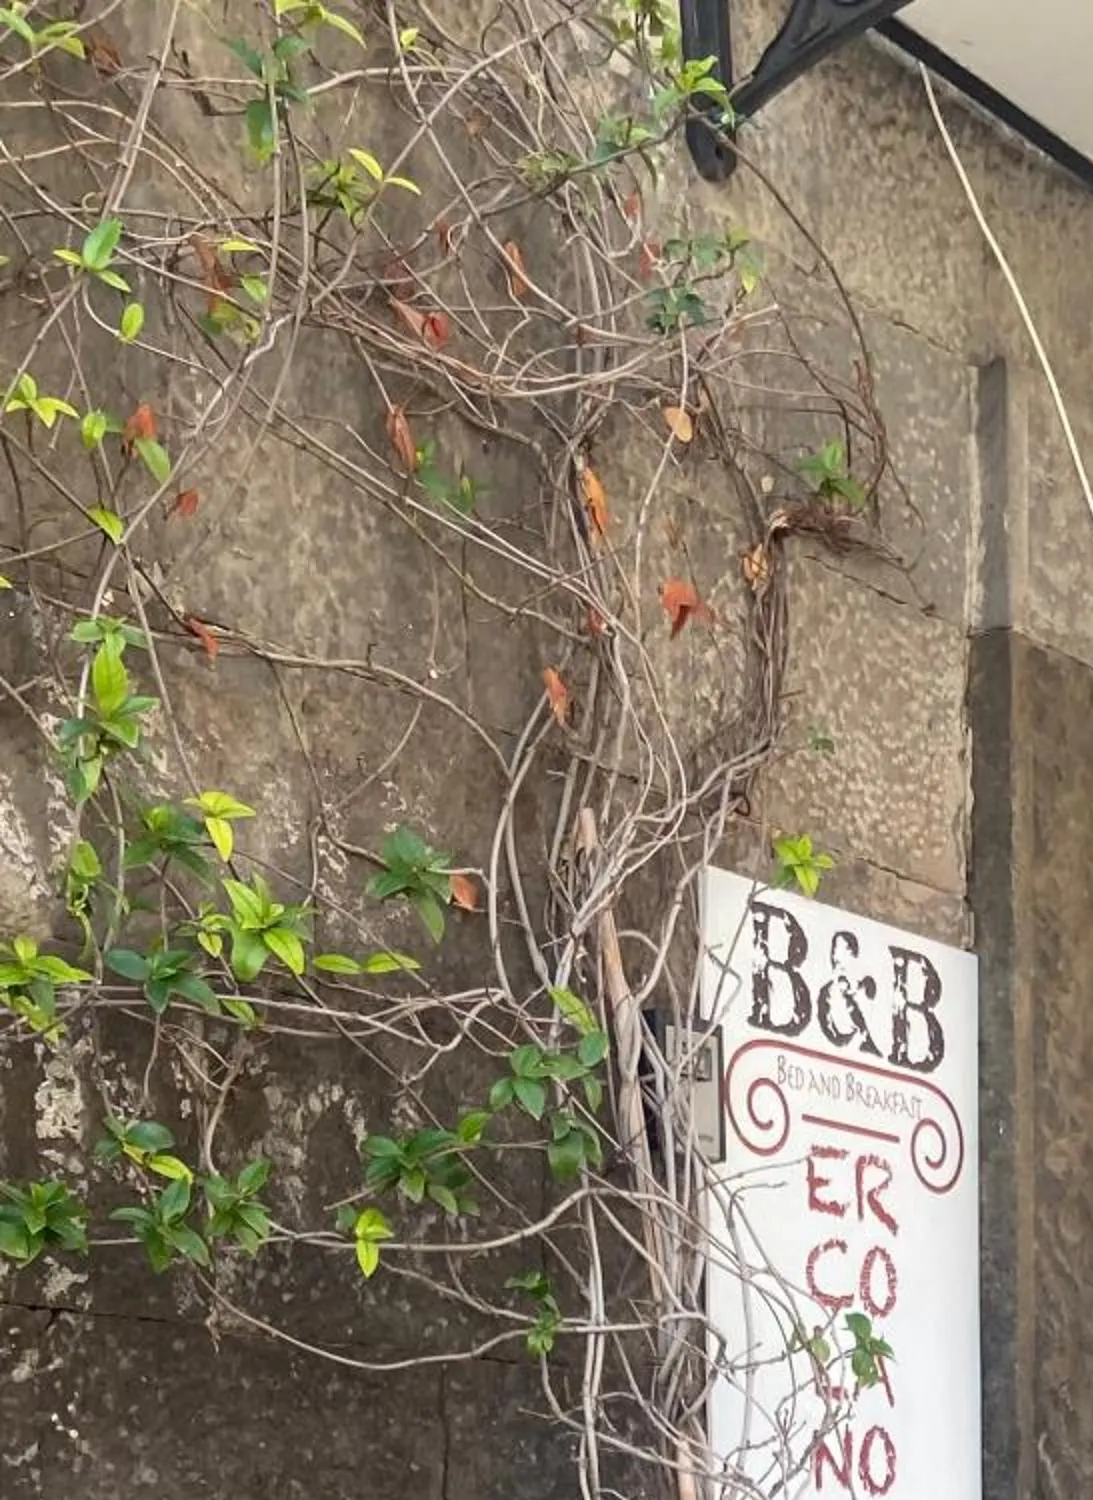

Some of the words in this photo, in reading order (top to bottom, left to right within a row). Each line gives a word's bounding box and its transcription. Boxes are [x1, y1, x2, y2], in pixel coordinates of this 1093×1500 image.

[747, 901, 945, 1073] B&B
[805, 1143, 898, 1236] ER
[805, 1234, 898, 1318] CO
[811, 1424, 897, 1497] NO
